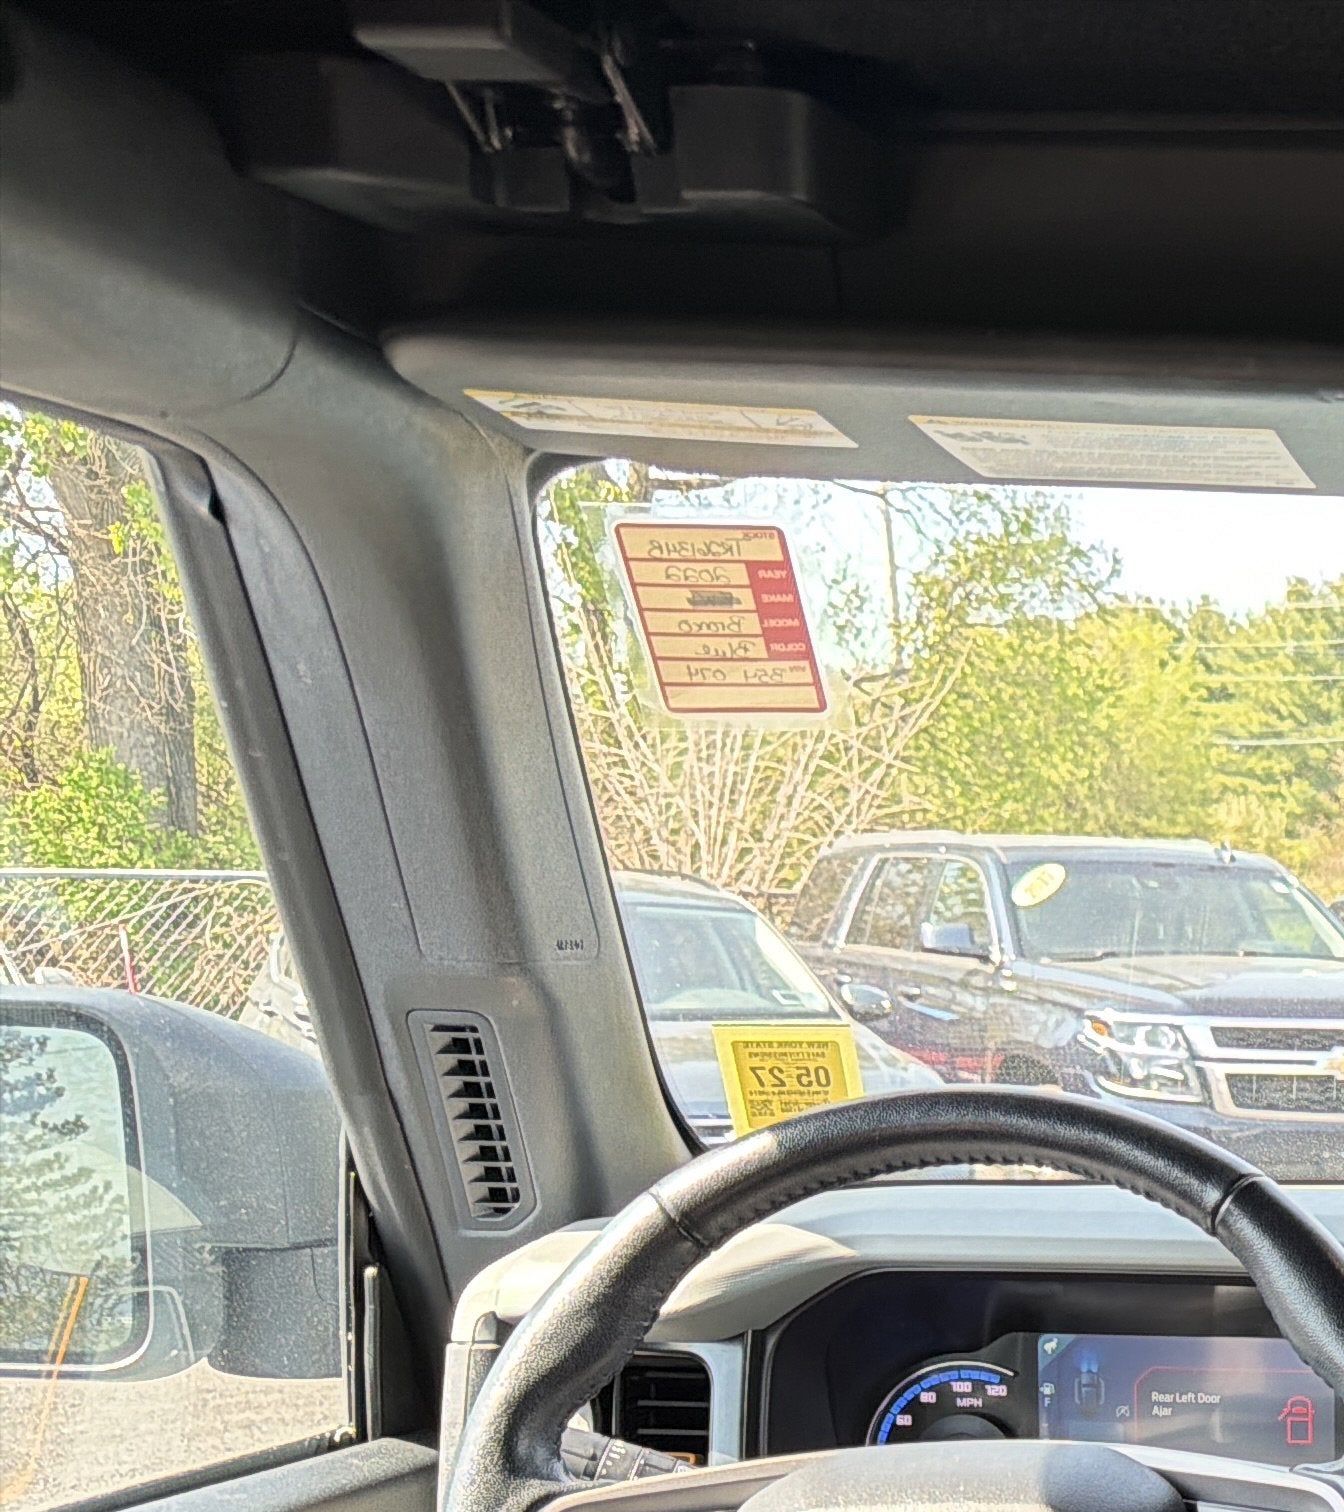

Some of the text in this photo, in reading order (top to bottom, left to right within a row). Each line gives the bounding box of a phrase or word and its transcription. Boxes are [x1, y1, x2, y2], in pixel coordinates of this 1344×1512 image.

[950, 1382, 972, 1392] 100
[985, 1385, 1008, 1397] 120
[957, 1398, 983, 1408] MPH
[1151, 1392, 1221, 1404] Rear Left Door
[1152, 1405, 1173, 1417] Ajar
